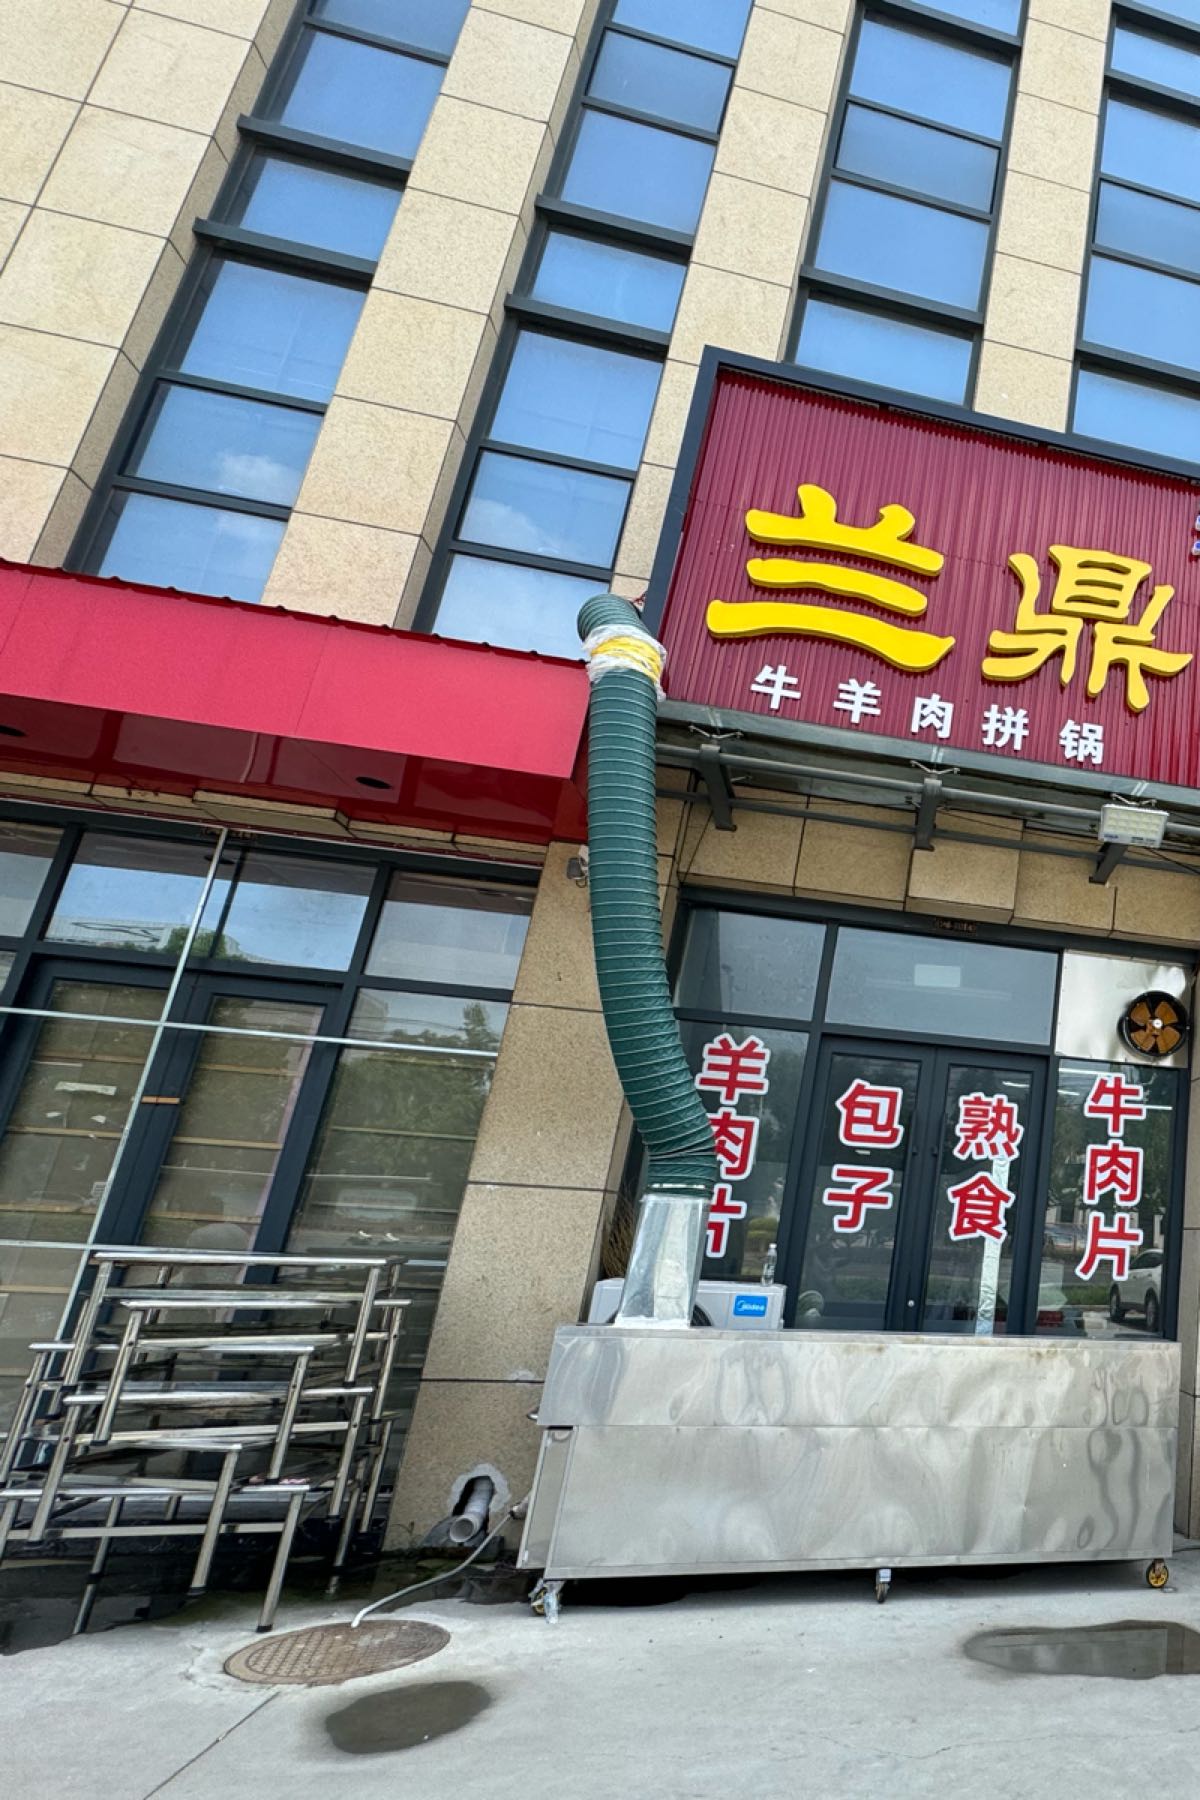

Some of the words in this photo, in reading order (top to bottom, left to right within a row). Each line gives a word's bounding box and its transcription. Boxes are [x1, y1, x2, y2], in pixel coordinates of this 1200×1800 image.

[750, 664, 1104, 764] 牛羊肉拼锅
[823, 1078, 904, 1233] 包子
[947, 1093, 1024, 1242] 熟食
[1075, 1072, 1147, 1281] 牛肉片
